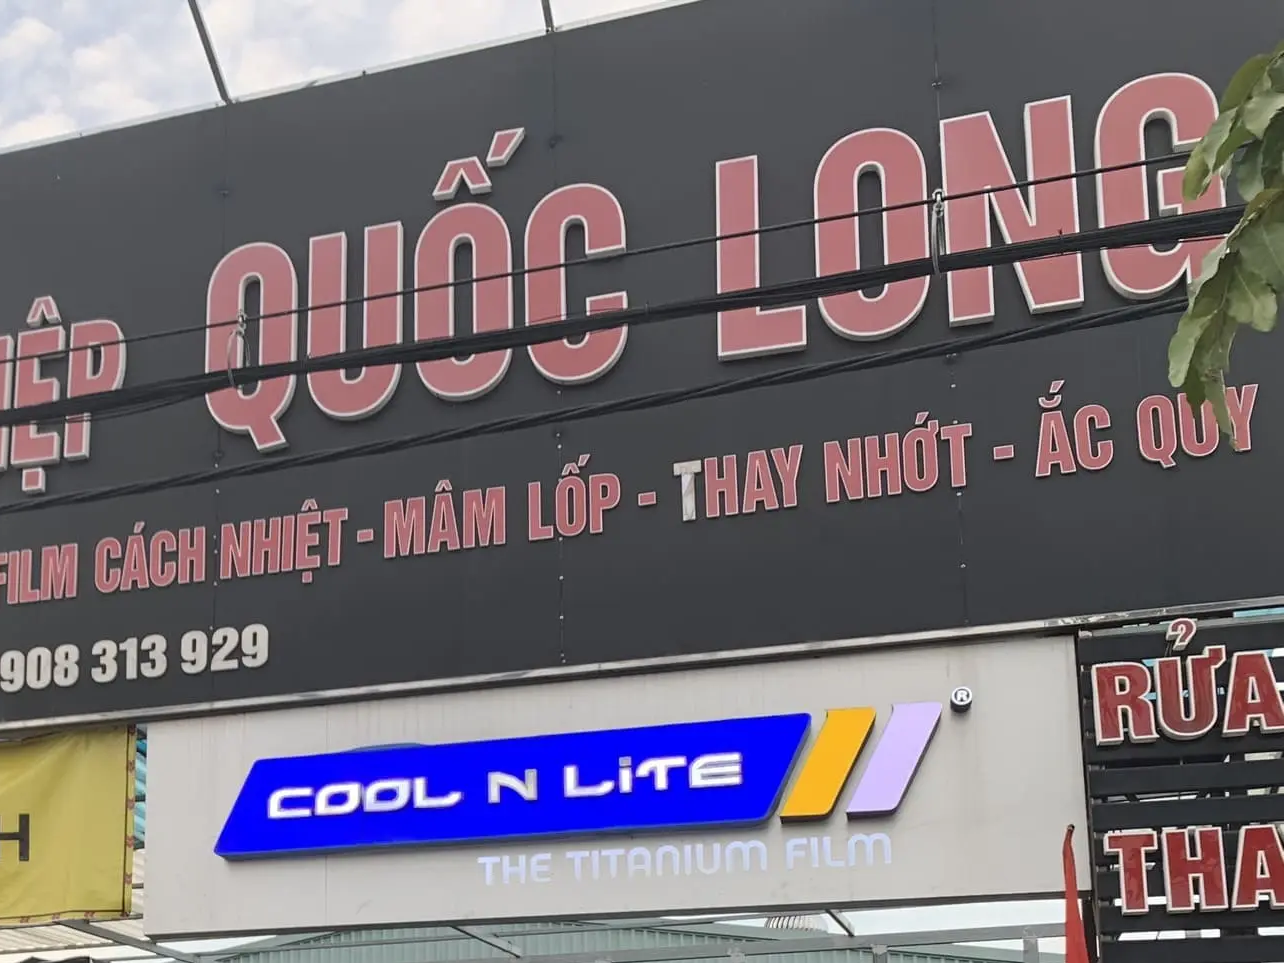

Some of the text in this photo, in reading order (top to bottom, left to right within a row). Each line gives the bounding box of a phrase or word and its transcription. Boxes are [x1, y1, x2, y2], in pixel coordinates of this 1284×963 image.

[205, 127, 628, 452] QUỐC
[715, 71, 1229, 362] LONG
[93, 521, 206, 593] CÁCH
[219, 498, 349, 584] NHIỆT
[383, 479, 506, 559] MÂM
[527, 453, 621, 542] LỐP
[672, 443, 804, 522] THAY
[823, 410, 973, 504] NHỚT
[1034, 379, 1115, 478] ẮC
[1135, 383, 1259, 469] QUY
[90, 632, 168, 684] 313
[180, 622, 270, 675] 929
[1091, 617, 1284, 746] RỬA
[267, 777, 463, 819] COOL
[487, 768, 538, 804] N
[477, 832, 892, 886] THE TITANIUM FILM
